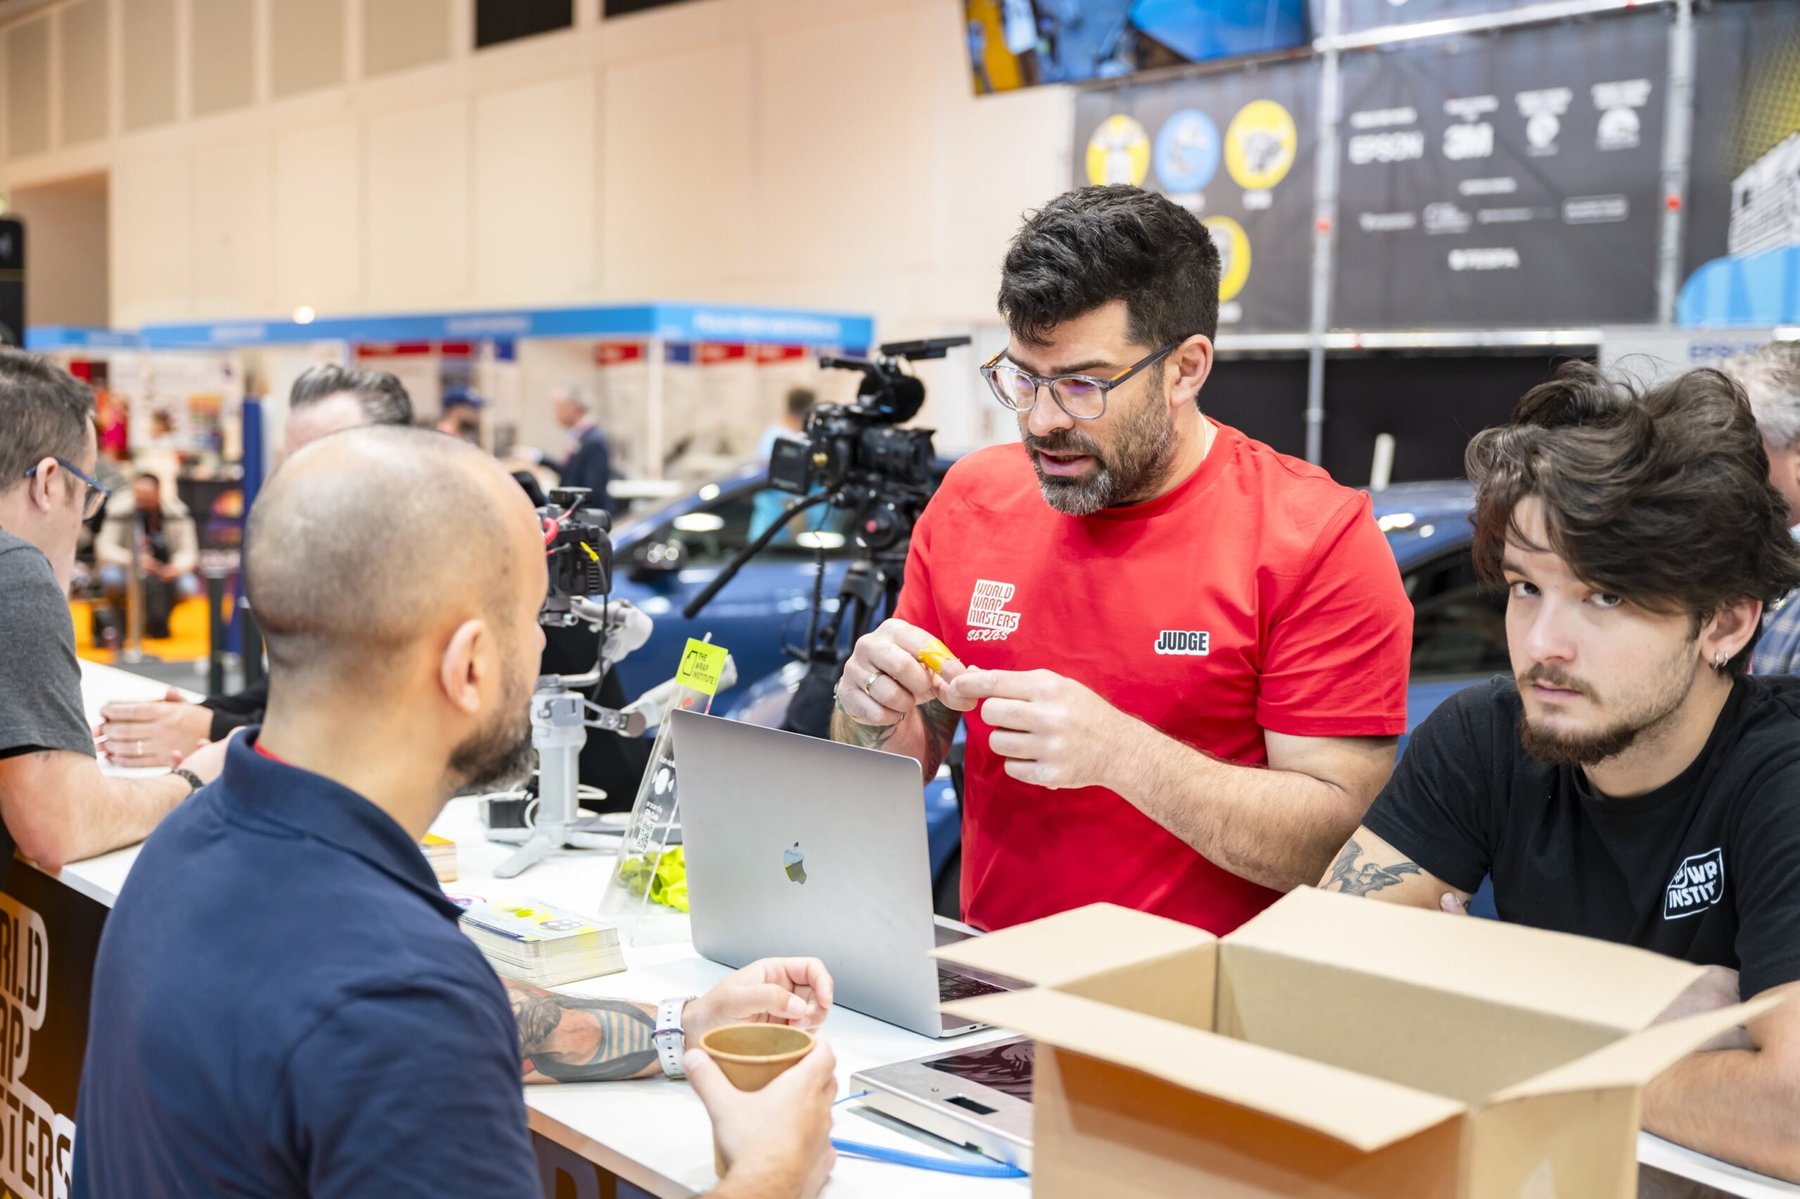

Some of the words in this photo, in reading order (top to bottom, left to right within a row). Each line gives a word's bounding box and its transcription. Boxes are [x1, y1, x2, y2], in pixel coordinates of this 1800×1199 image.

[976, 583, 1012, 599] WORLD
[973, 596, 1002, 611] WRAP
[969, 610, 1016, 628] MASTERS
[1157, 631, 1207, 652] JUDGE
[0, 1080, 73, 1199] TERS
